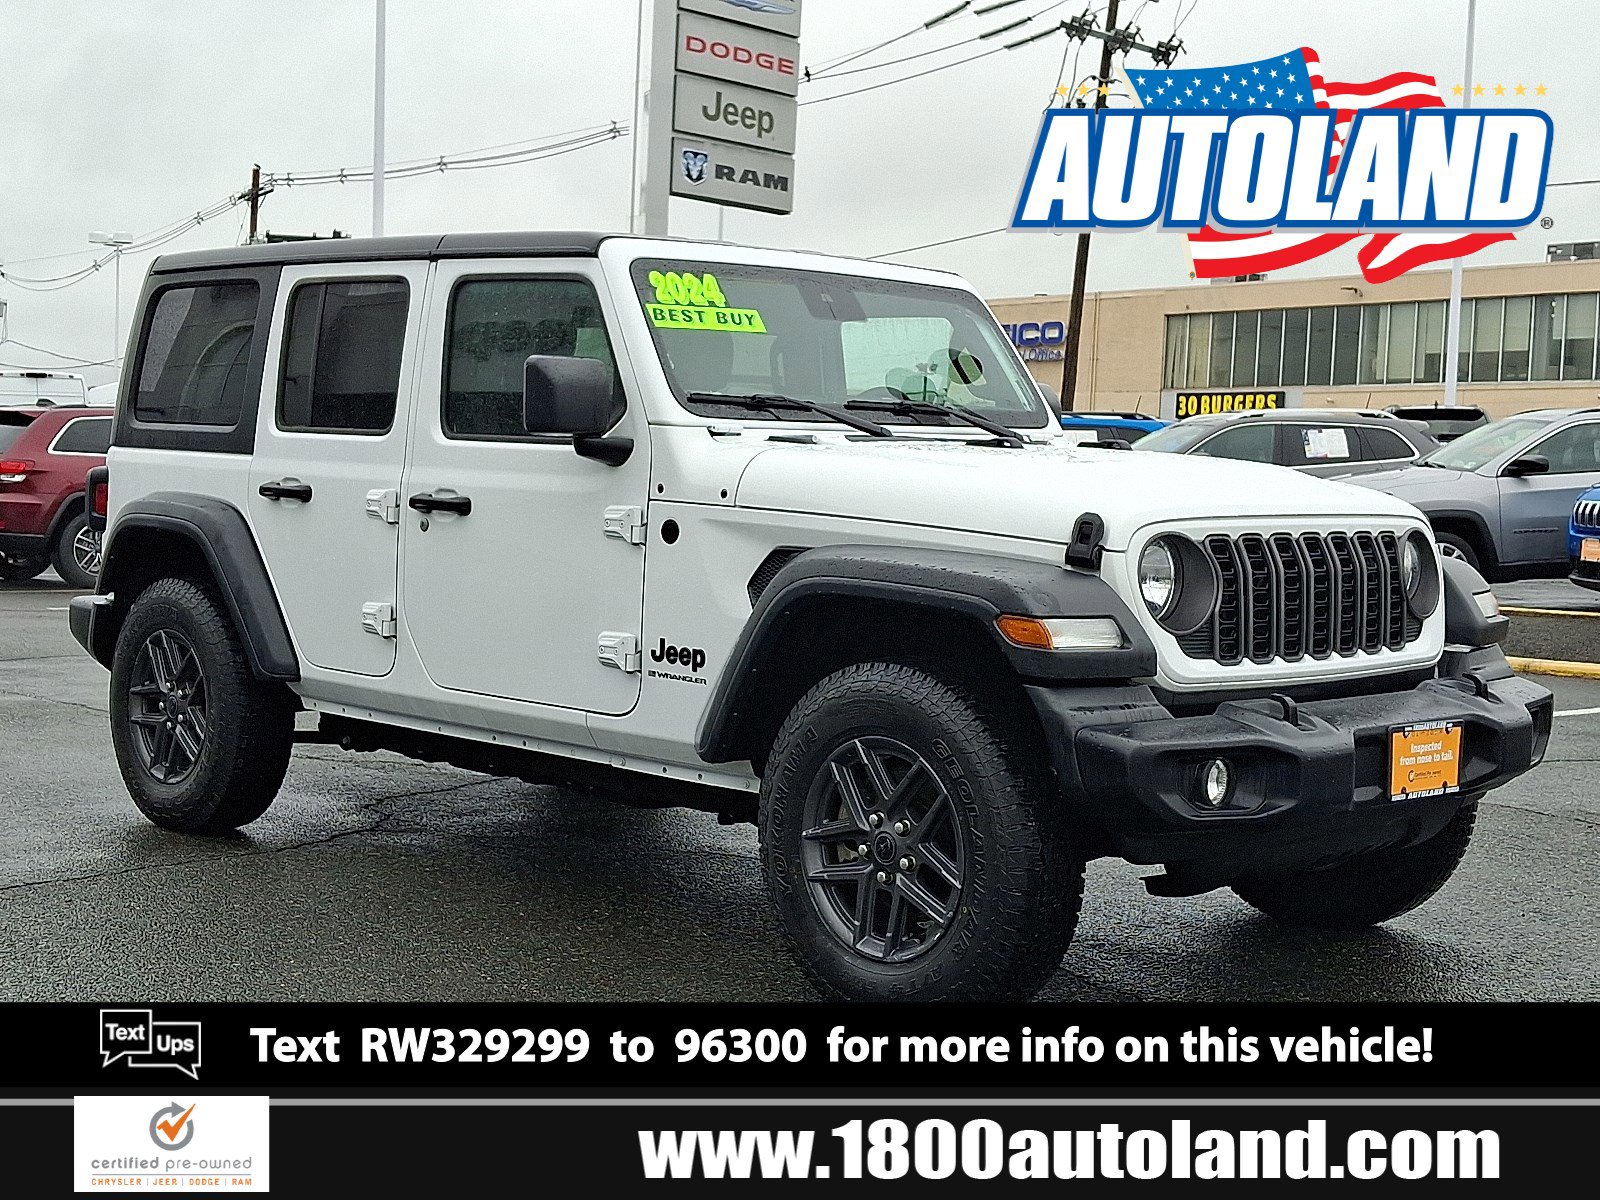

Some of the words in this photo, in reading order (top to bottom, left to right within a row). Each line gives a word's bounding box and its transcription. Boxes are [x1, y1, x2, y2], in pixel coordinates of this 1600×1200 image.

[685, 35, 795, 75] DODGE
[701, 91, 774, 138] Jeep
[714, 163, 789, 192] RAM
[648, 270, 726, 307] 2024
[652, 308, 706, 324] BEST
[715, 311, 755, 326] BUY
[1178, 395, 1198, 416] 30
[1200, 393, 1277, 415] BURGERS
[650, 637, 706, 673] Jeep
[657, 670, 708, 686] WRANGLER
[1400, 755, 1417, 766] from
[1433, 752, 1441, 762] to
[1410, 740, 1443, 754] Inspected
